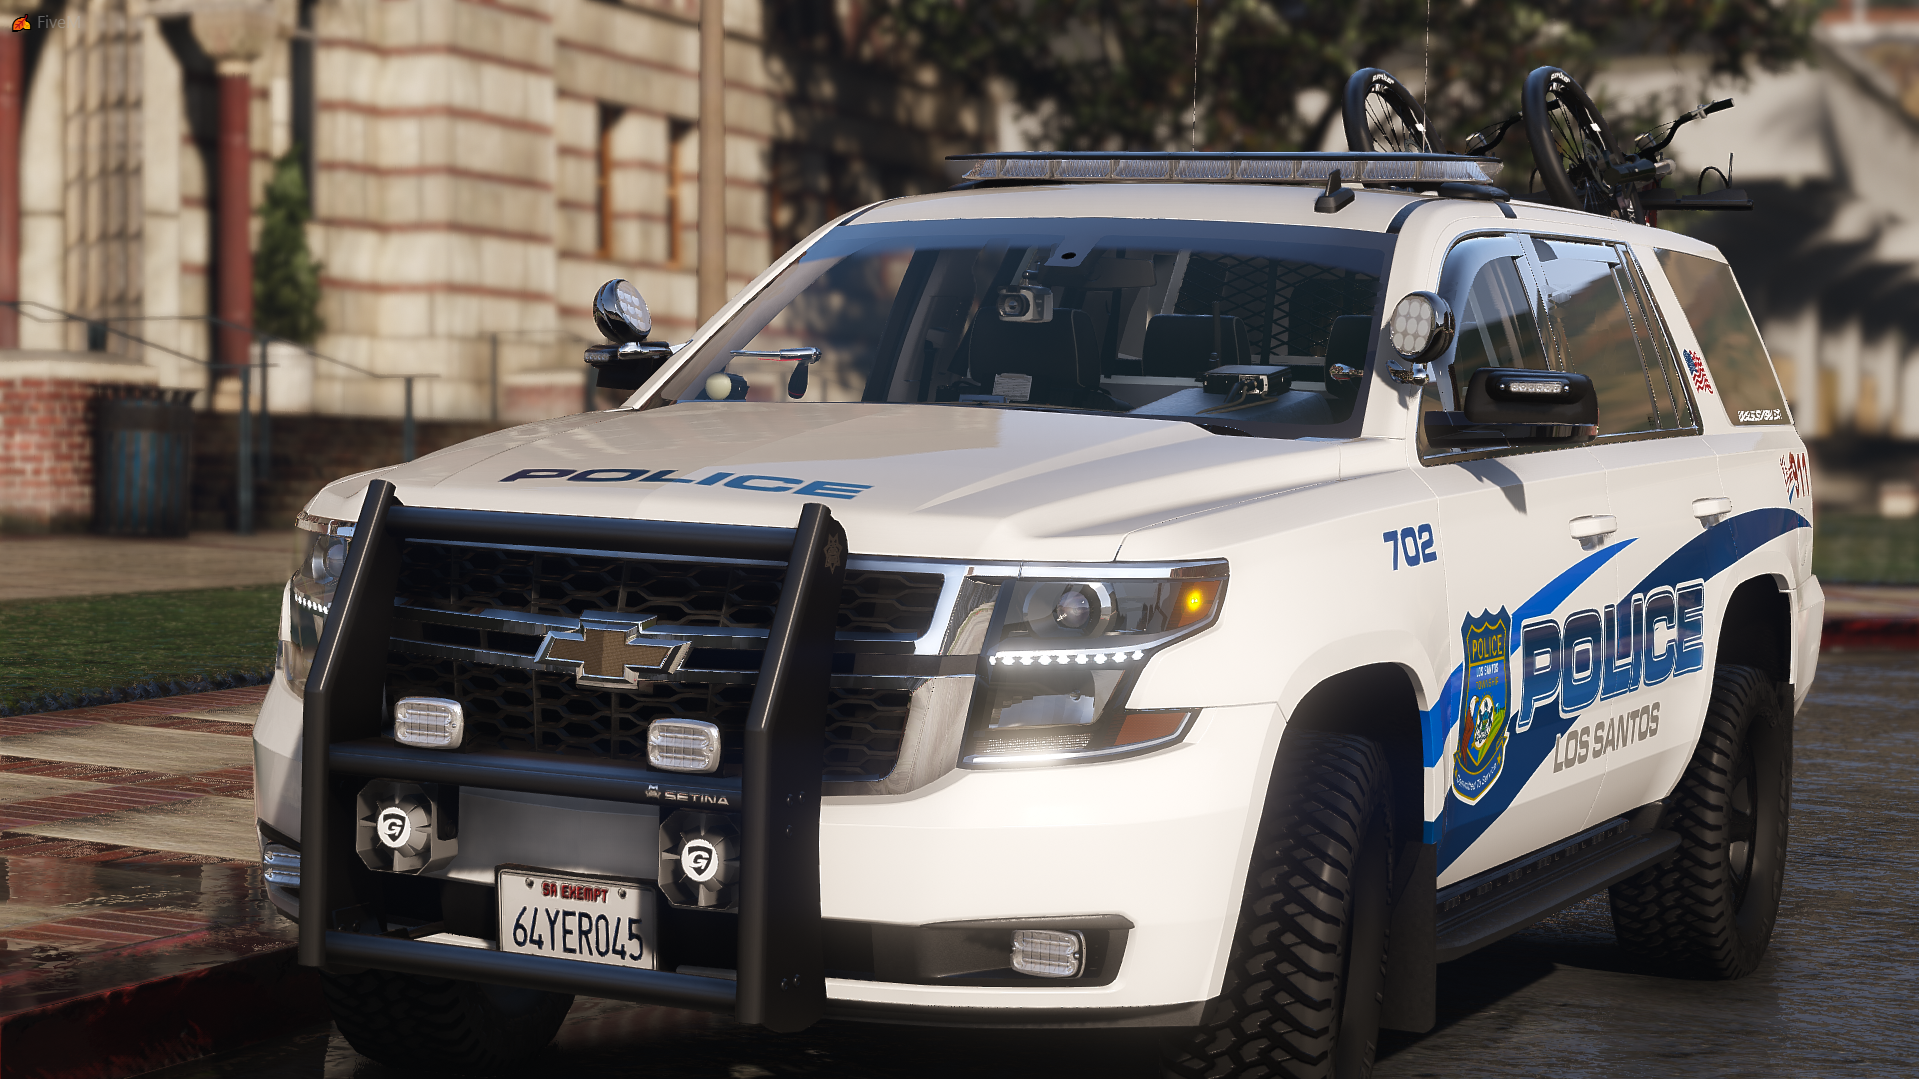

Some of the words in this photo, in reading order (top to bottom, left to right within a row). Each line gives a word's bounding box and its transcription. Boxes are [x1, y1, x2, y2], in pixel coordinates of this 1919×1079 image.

[498, 468, 874, 500] POLICE
[1383, 523, 1438, 571] 702
[1472, 634, 1503, 661] POLICE
[1517, 578, 1705, 733] POLICE
[1553, 727, 1591, 774] LOS
[1592, 702, 1661, 760] SANTOS
[664, 790, 729, 806] SETINA
[541, 882, 558, 898] SA
[561, 884, 609, 904] EXEMPT
